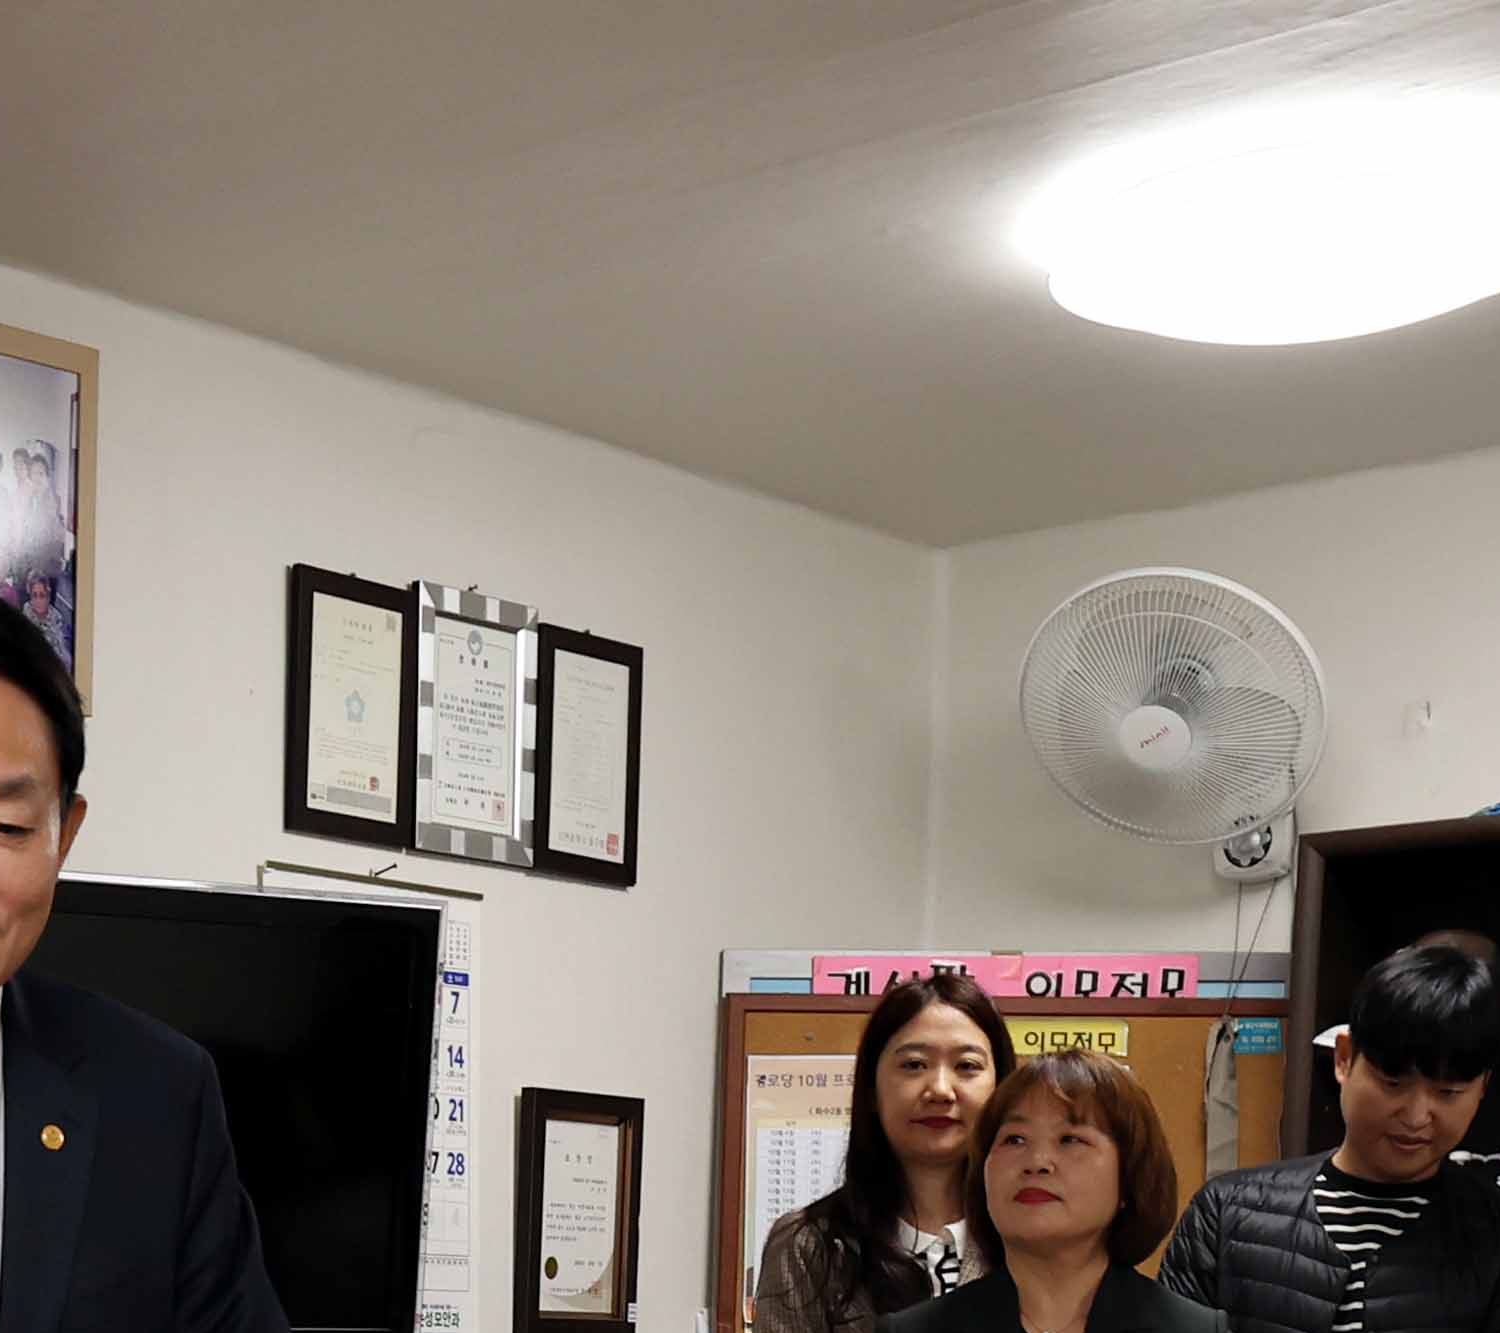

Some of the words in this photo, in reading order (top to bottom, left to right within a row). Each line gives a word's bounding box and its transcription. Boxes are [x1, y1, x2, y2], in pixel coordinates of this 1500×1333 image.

[450, 991, 460, 1015] 7
[447, 1044, 465, 1069] 14
[798, 1073, 828, 1087] 10월
[448, 1099, 464, 1123] 21
[446, 1152, 465, 1175] 28
